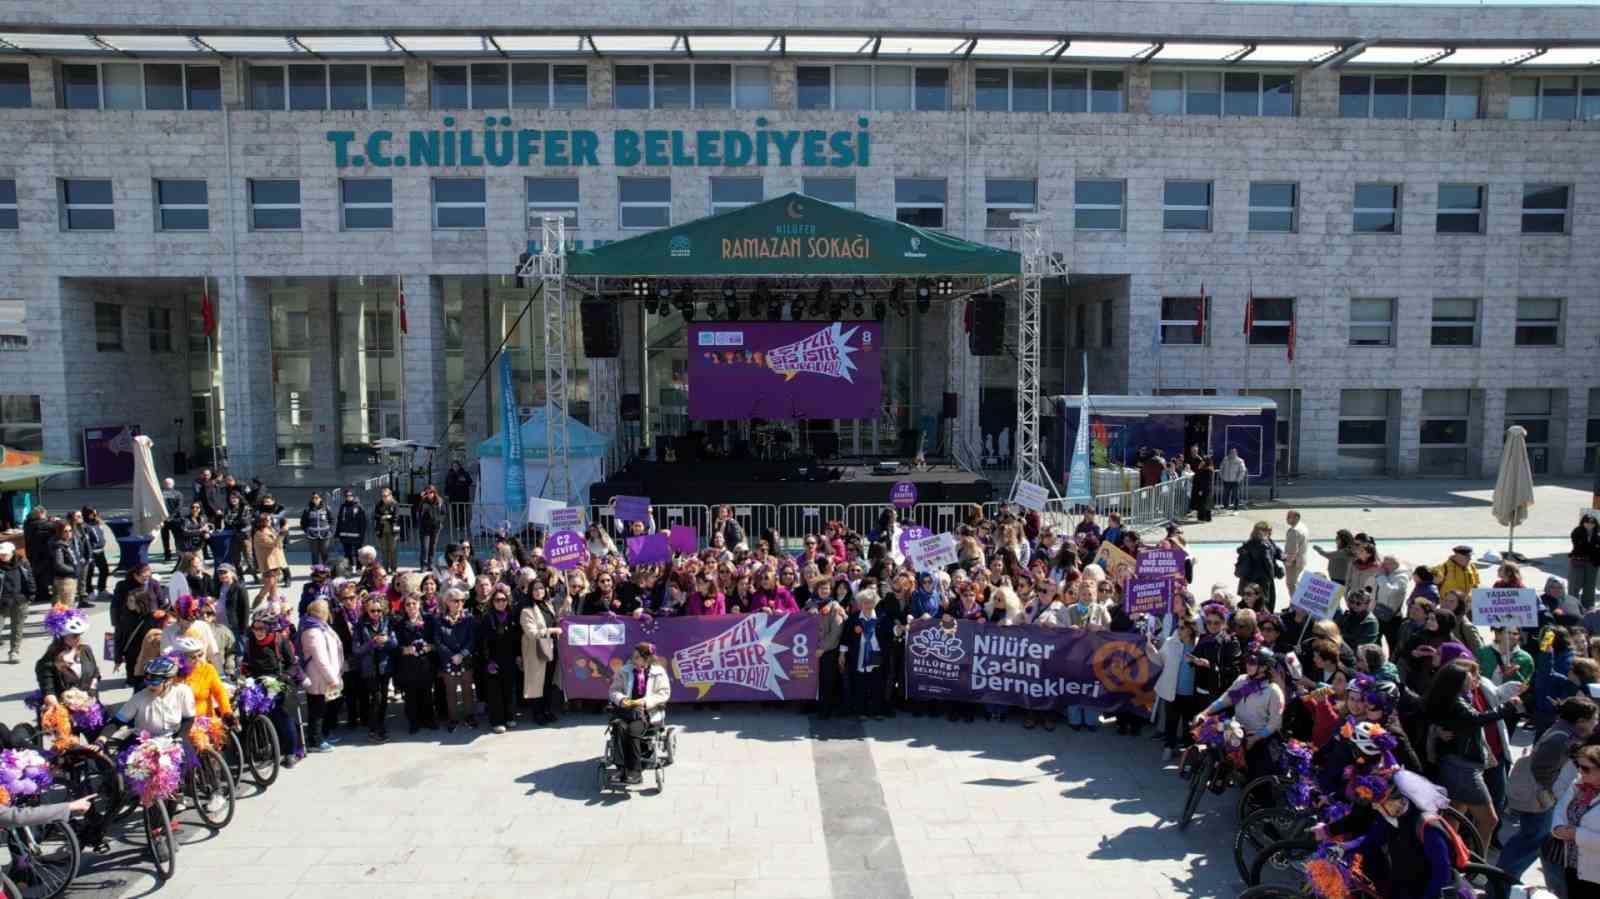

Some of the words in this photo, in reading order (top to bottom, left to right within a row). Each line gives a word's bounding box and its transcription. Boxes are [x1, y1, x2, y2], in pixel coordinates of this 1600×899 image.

[614, 116, 870, 168] BELEDİYESİ
[721, 238, 801, 259] RAMAZAN
[807, 235, 870, 259] SOKAĞI
[862, 331, 872, 342] 8
[556, 535, 570, 546] C2
[909, 529, 922, 538] C2
[793, 633, 808, 658] 8
[974, 634, 1055, 659] Nilüfer
[678, 655, 714, 674] SES
[720, 644, 769, 668] İSTER
[913, 658, 960, 671] NİLÜFER
[972, 655, 1040, 679] Kadın
[696, 664, 771, 689] BURADAYIZ
[971, 673, 1100, 698] Dernekleri
